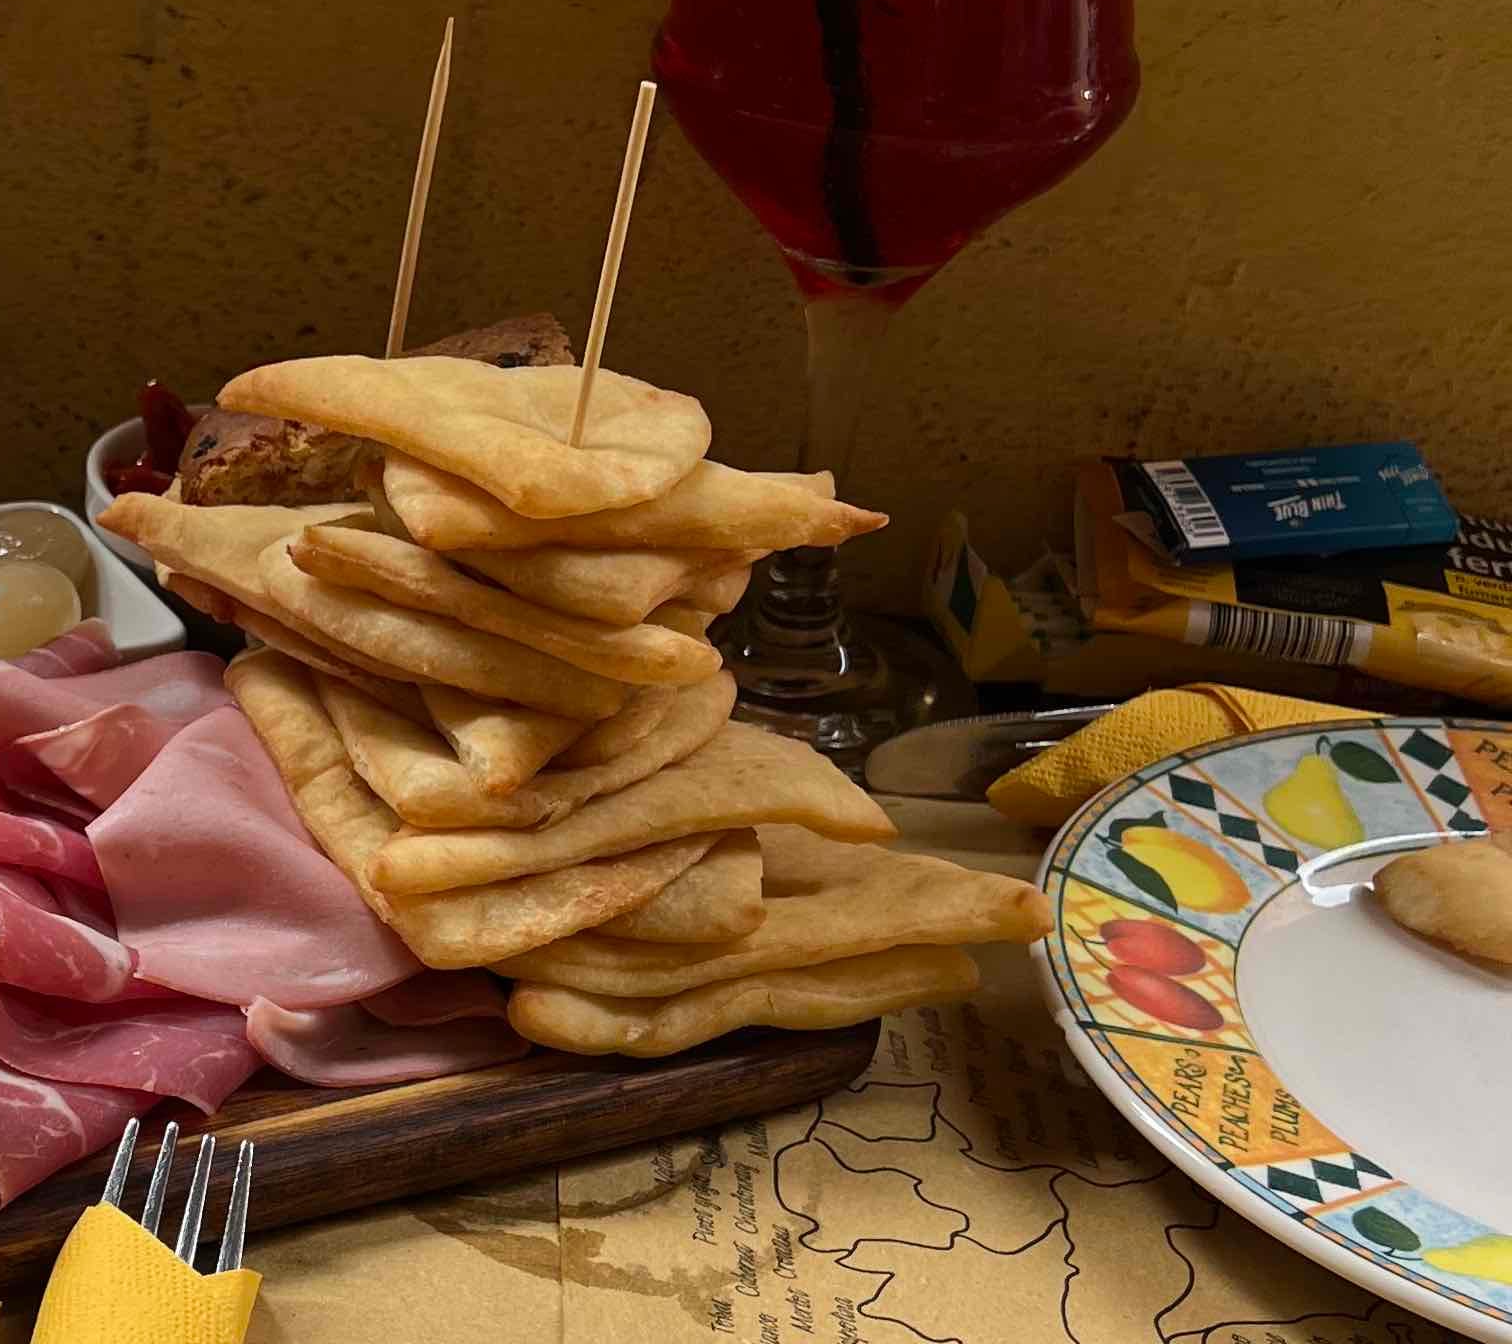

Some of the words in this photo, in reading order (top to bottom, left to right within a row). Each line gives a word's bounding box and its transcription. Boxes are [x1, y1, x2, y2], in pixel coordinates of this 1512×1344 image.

[1171, 1054, 1207, 1118] PEARS
[1219, 1062, 1252, 1152] PEACHES
[1271, 1088, 1301, 1146] PLUMS
